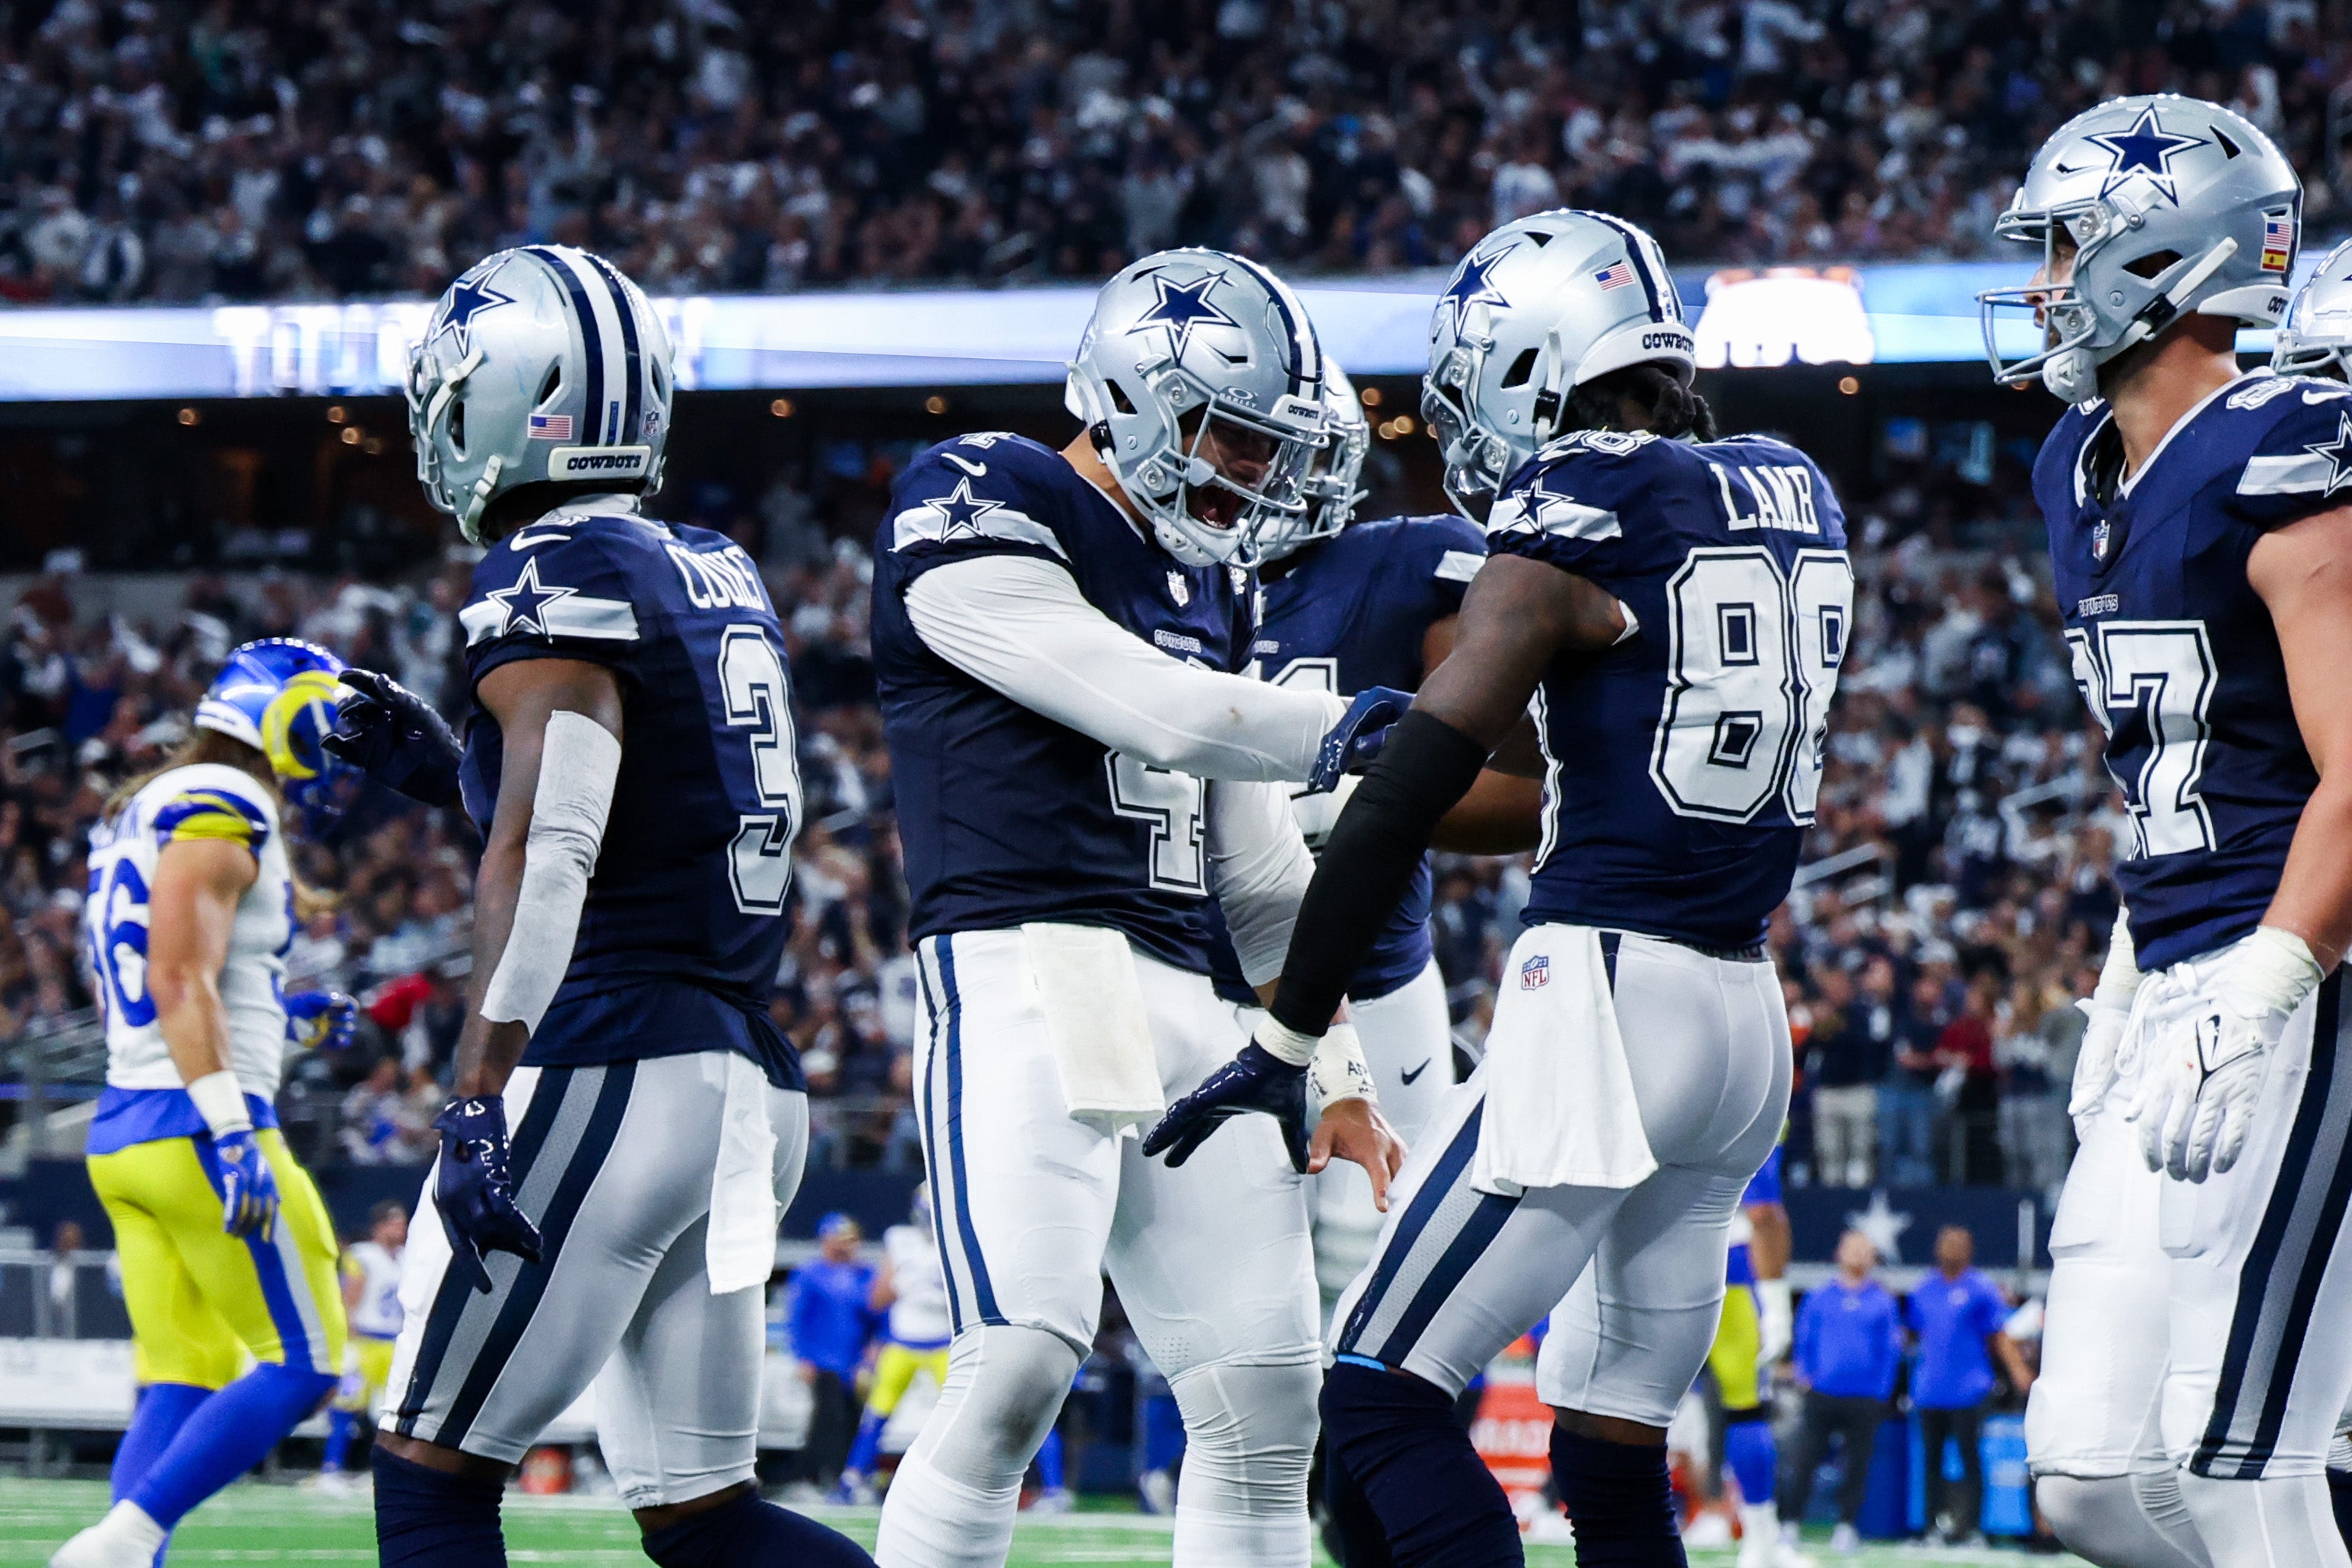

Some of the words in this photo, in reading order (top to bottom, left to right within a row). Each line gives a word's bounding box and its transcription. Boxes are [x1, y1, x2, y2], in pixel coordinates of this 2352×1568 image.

[567, 455, 642, 471] COWBOYS
[1709, 462, 1820, 535] LAMB
[1649, 545, 1855, 828] 88
[717, 624, 804, 916] 3
[1524, 969, 1547, 988] NFL
